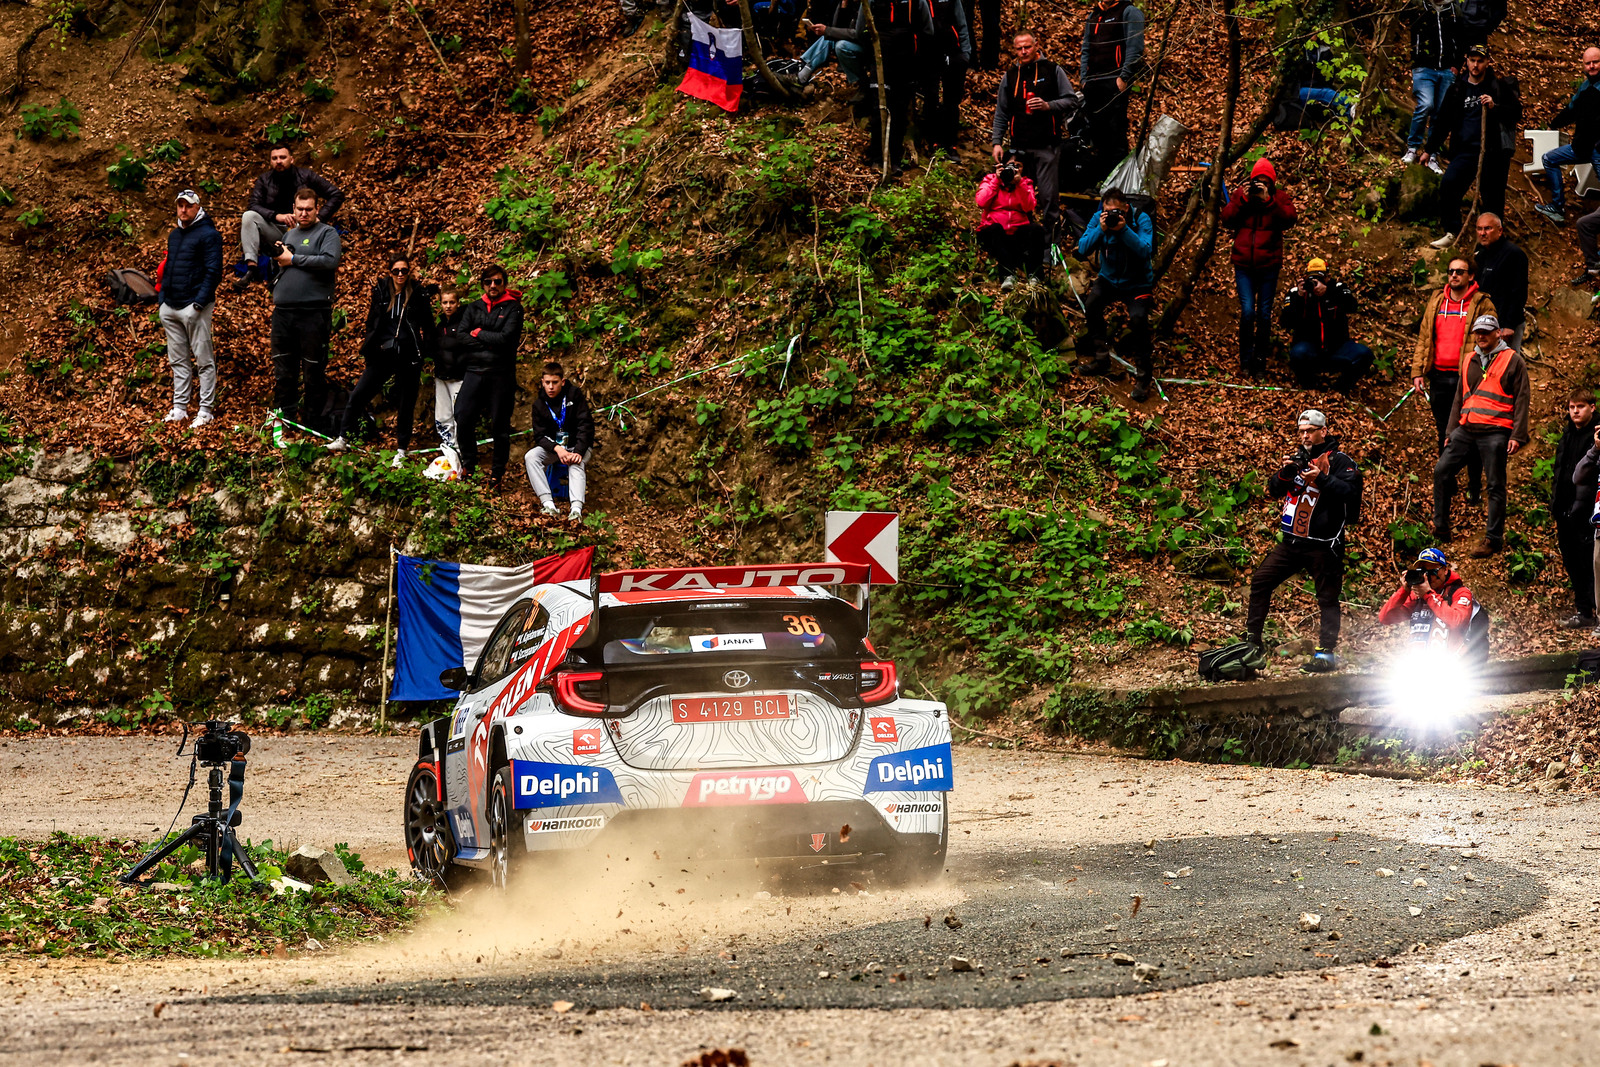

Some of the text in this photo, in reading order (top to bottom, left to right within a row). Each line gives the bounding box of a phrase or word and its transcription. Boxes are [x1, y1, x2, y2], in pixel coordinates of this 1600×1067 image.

[1296, 485, 1320, 534] CRO 21
[619, 567, 846, 592] KAJTO
[782, 614, 822, 637] 36
[723, 638, 754, 646] JANAF
[678, 699, 786, 718] S 4129 BCL
[877, 758, 944, 785] Delphi
[520, 771, 599, 799] Delphi
[698, 775, 791, 803] petrygo
